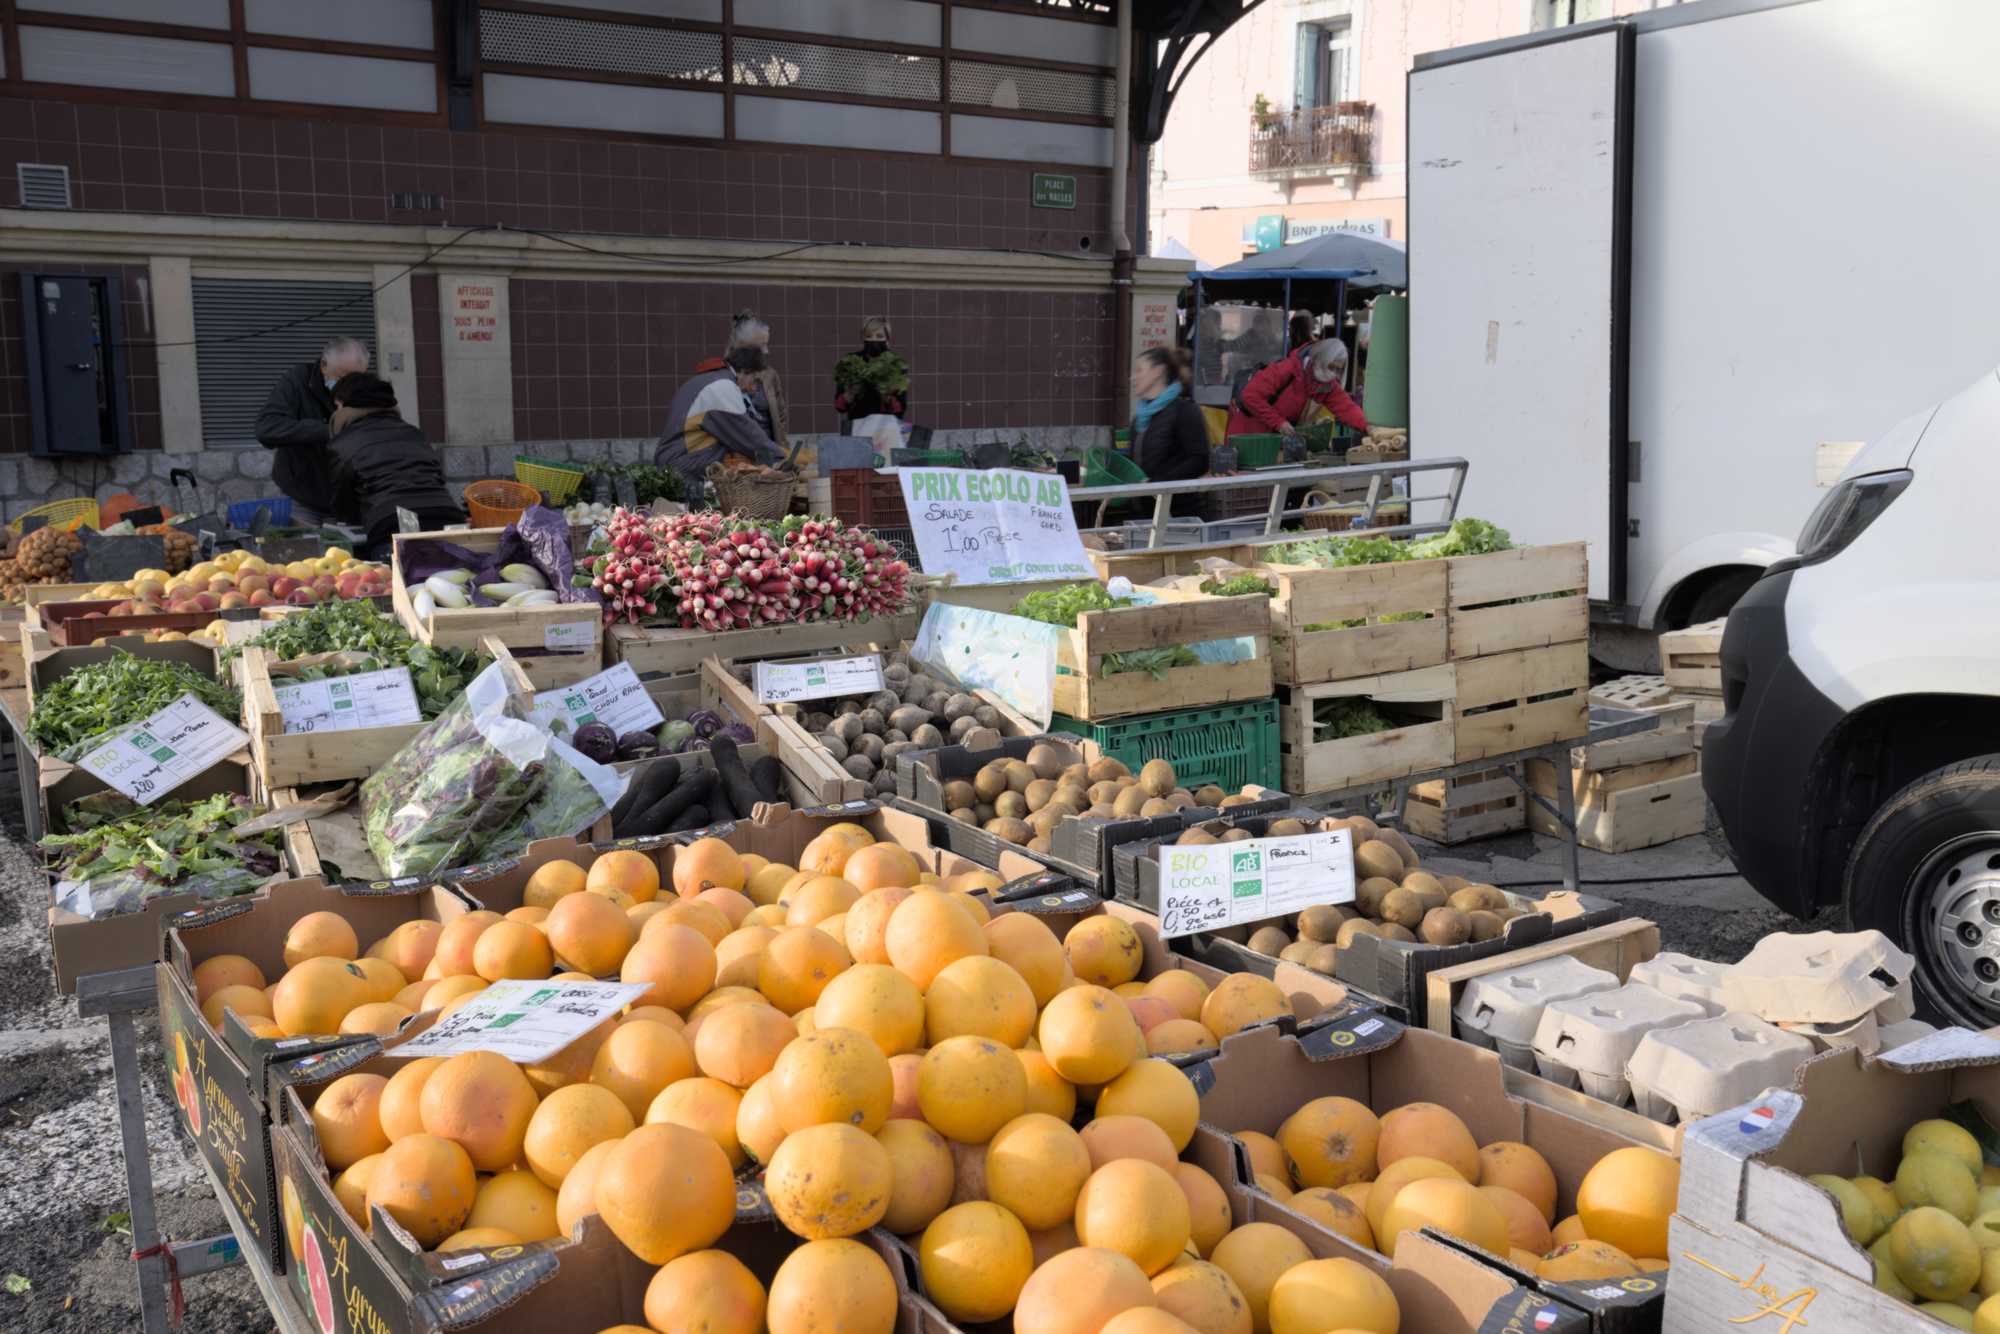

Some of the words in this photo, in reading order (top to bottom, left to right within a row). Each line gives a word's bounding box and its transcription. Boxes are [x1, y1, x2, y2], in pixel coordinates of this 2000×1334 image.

[1041, 180, 1064, 189] PLACE
[1048, 192, 1072, 202] HALLES
[1292, 226, 1317, 237] BNP
[912, 472, 961, 501] PRIX
[966, 473, 1031, 503] ECOLO
[1037, 479, 1062, 507] AB
[924, 503, 976, 521] SALADE
[1031, 507, 1063, 520] FRANCE
[1057, 562, 1088, 574] LOCAL
[91, 749, 119, 769] BIO
[1171, 853, 1208, 872] BIO
[1233, 856, 1259, 873] AB
[1171, 876, 1218, 889] LOCAL
[196, 1038, 247, 1142] Agrumes
